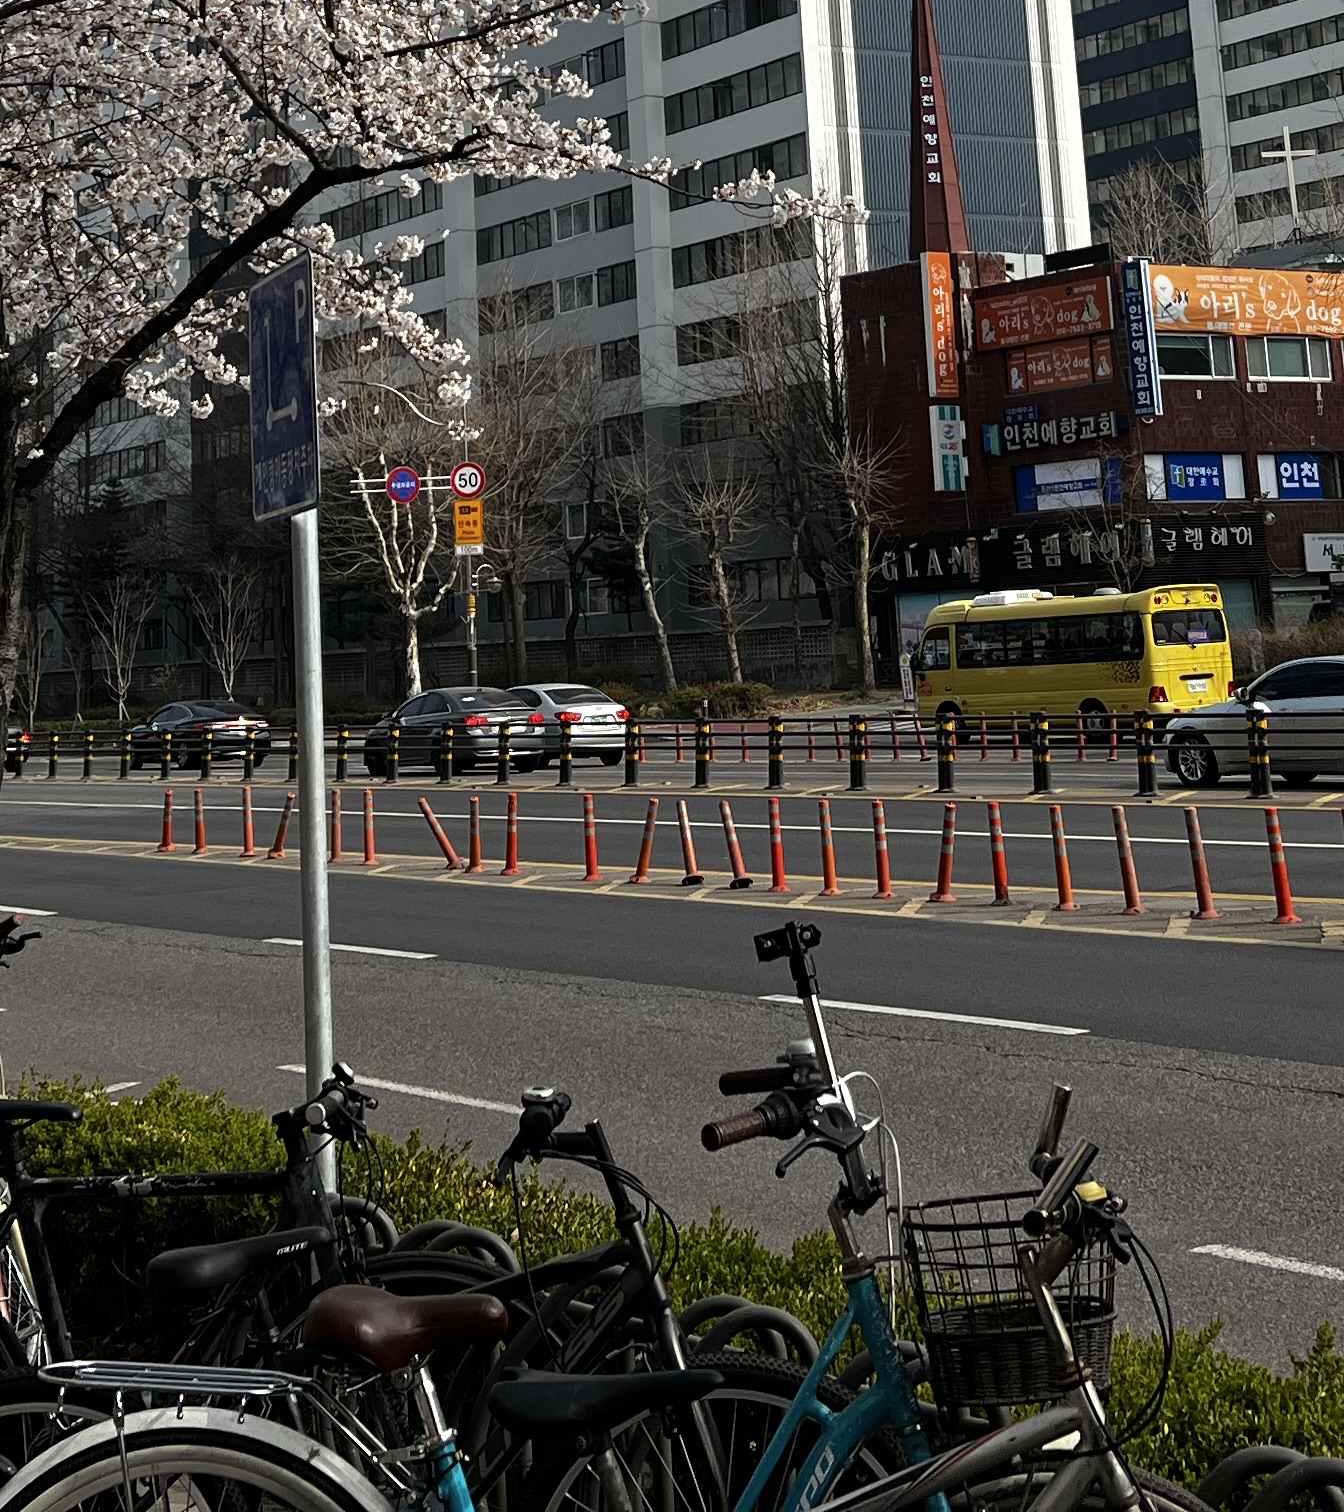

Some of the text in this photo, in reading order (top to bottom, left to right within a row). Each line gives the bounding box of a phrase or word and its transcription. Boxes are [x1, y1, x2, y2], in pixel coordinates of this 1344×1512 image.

[293, 277, 307, 344] P
[998, 308, 1079, 333] 아리's dog
[1199, 290, 1342, 326] 아리's dog
[937, 335, 948, 377] dog
[1027, 358, 1052, 375] 아리's
[1072, 356, 1091, 369] dog
[1129, 304, 1151, 405] 인천예향교회
[1003, 410, 1117, 451] 인천예향교회
[458, 472, 478, 488] 50
[1186, 466, 1220, 477] 대한예수교
[1279, 461, 1320, 488] 인천
[1160, 526, 1253, 551] 글램헤어
[881, 544, 972, 581] GLAM
